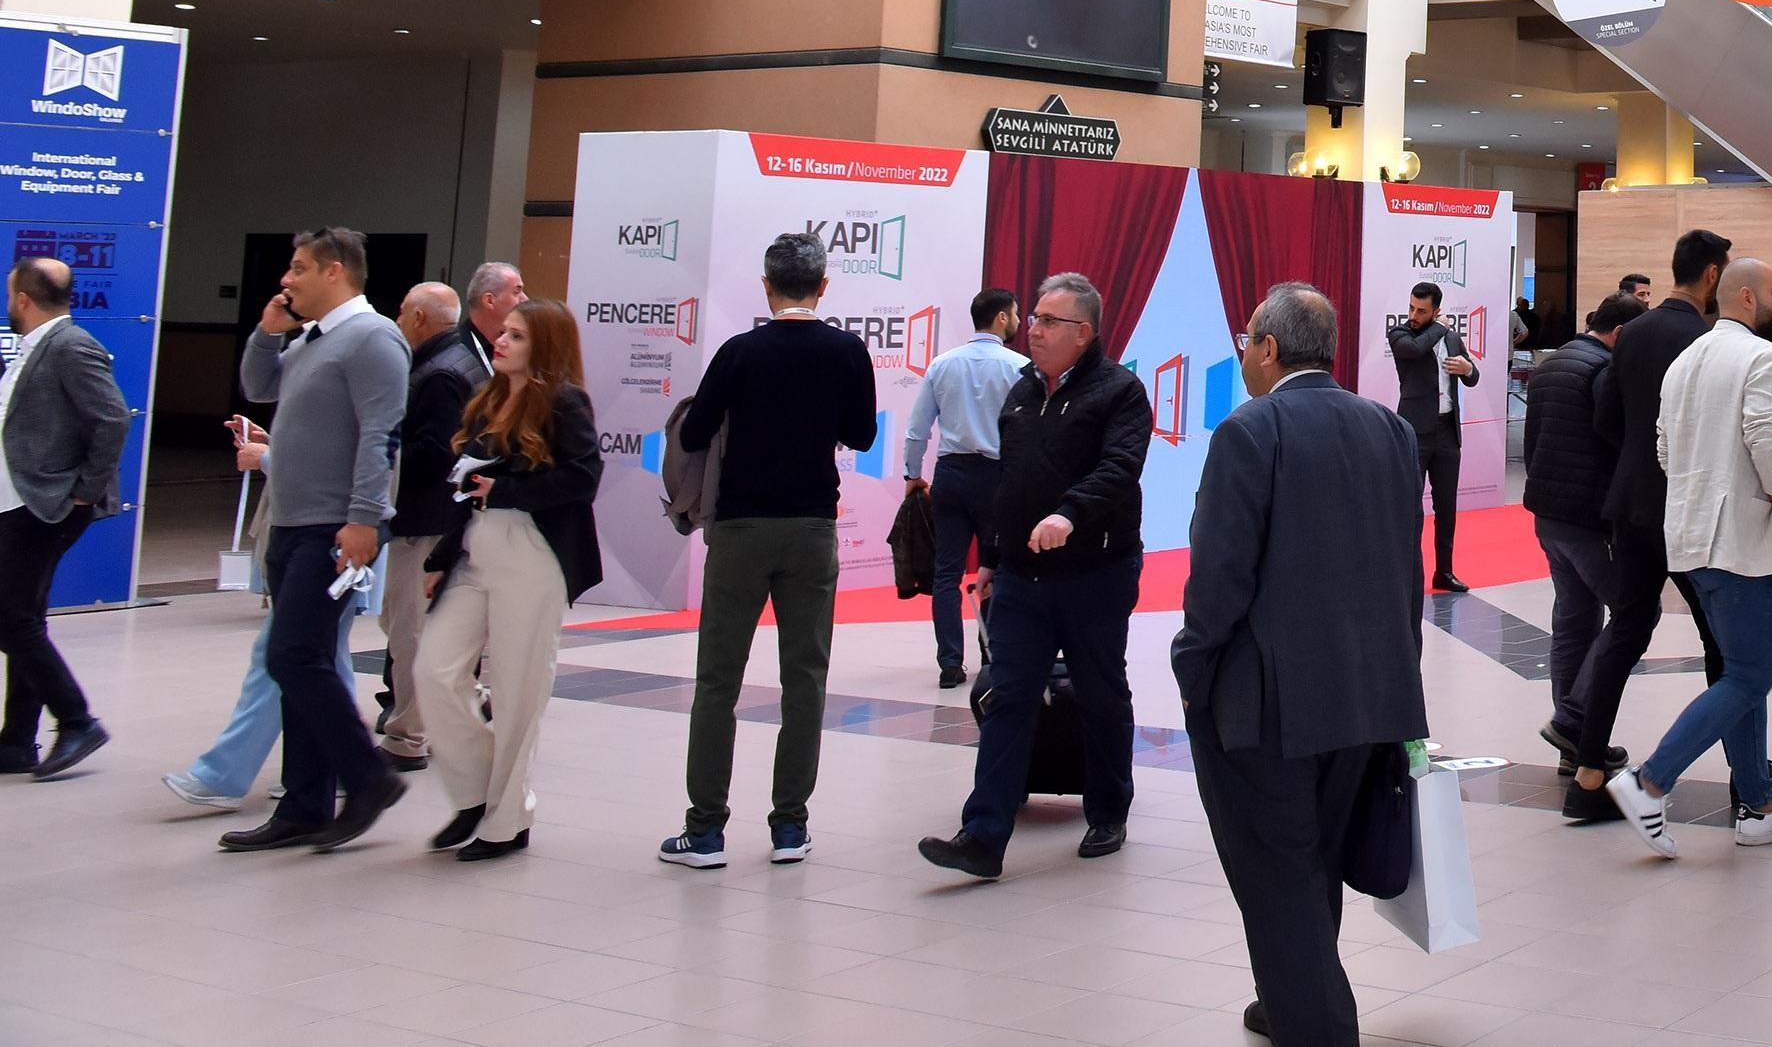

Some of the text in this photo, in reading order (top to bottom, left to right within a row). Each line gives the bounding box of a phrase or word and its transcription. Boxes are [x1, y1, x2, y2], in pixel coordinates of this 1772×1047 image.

[1207, 4, 1251, 22] LCOME TO
[1206, 20, 1257, 38] ASIA'S MOST
[1206, 36, 1268, 56] EHENSIVE FAIR
[31, 99, 127, 119] WindoShow
[997, 117, 1114, 140] SANA MİNNETTARIZ
[996, 134, 1114, 156] SEVGİLİ ATATÜRK
[32, 152, 117, 167] International
[766, 156, 802, 172] 12-16
[919, 167, 948, 182] 2022
[0, 165, 144, 182] Window, Door, Glass &
[21, 180, 122, 194] Equipment Fair
[1474, 205, 1490, 215] 2022
[618, 225, 662, 245] KAPI
[842, 259, 878, 274] DOOR
[1412, 244, 1452, 269] KAPI
[1433, 272, 1452, 283] DOOR
[587, 302, 676, 325] PENCERE
[599, 432, 642, 454] CAM
